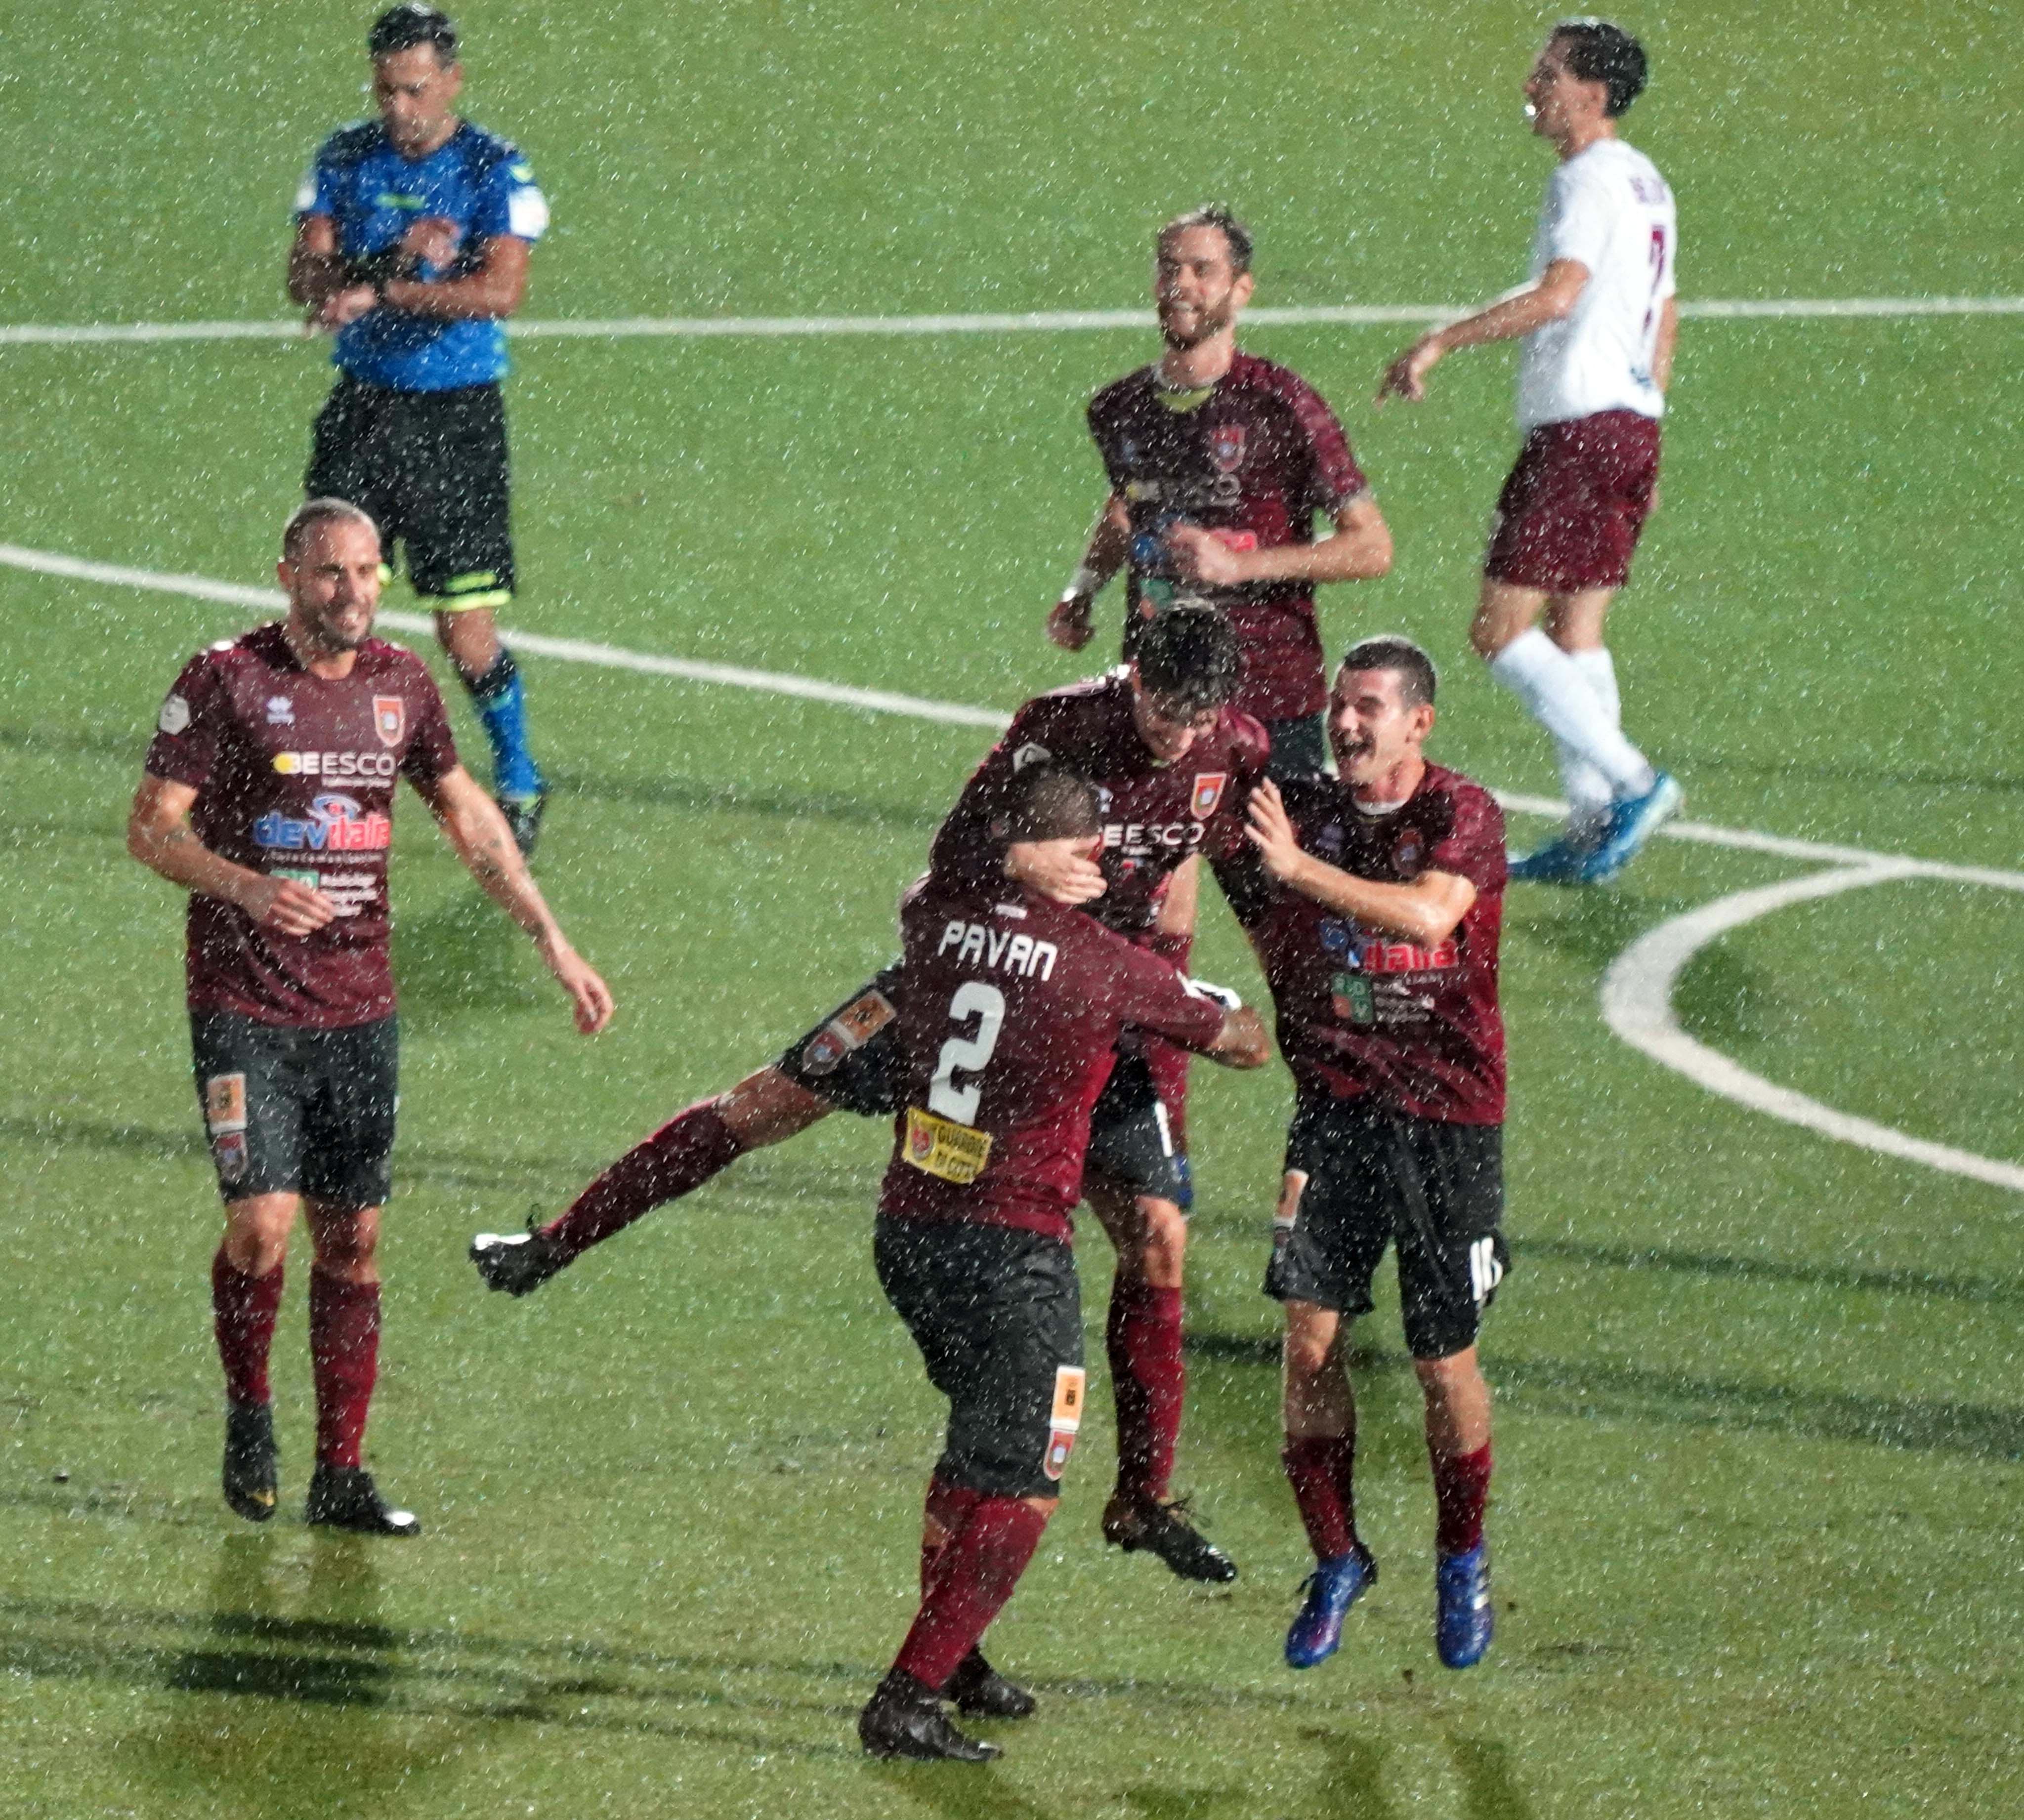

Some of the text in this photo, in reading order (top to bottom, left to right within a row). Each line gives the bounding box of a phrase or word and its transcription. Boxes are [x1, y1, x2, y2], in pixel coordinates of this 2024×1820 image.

[275, 751, 395, 776] BEESCO
[1097, 822, 1206, 846] EESCO
[937, 920, 1057, 981] PAVAN
[928, 982, 1005, 1126] 2
